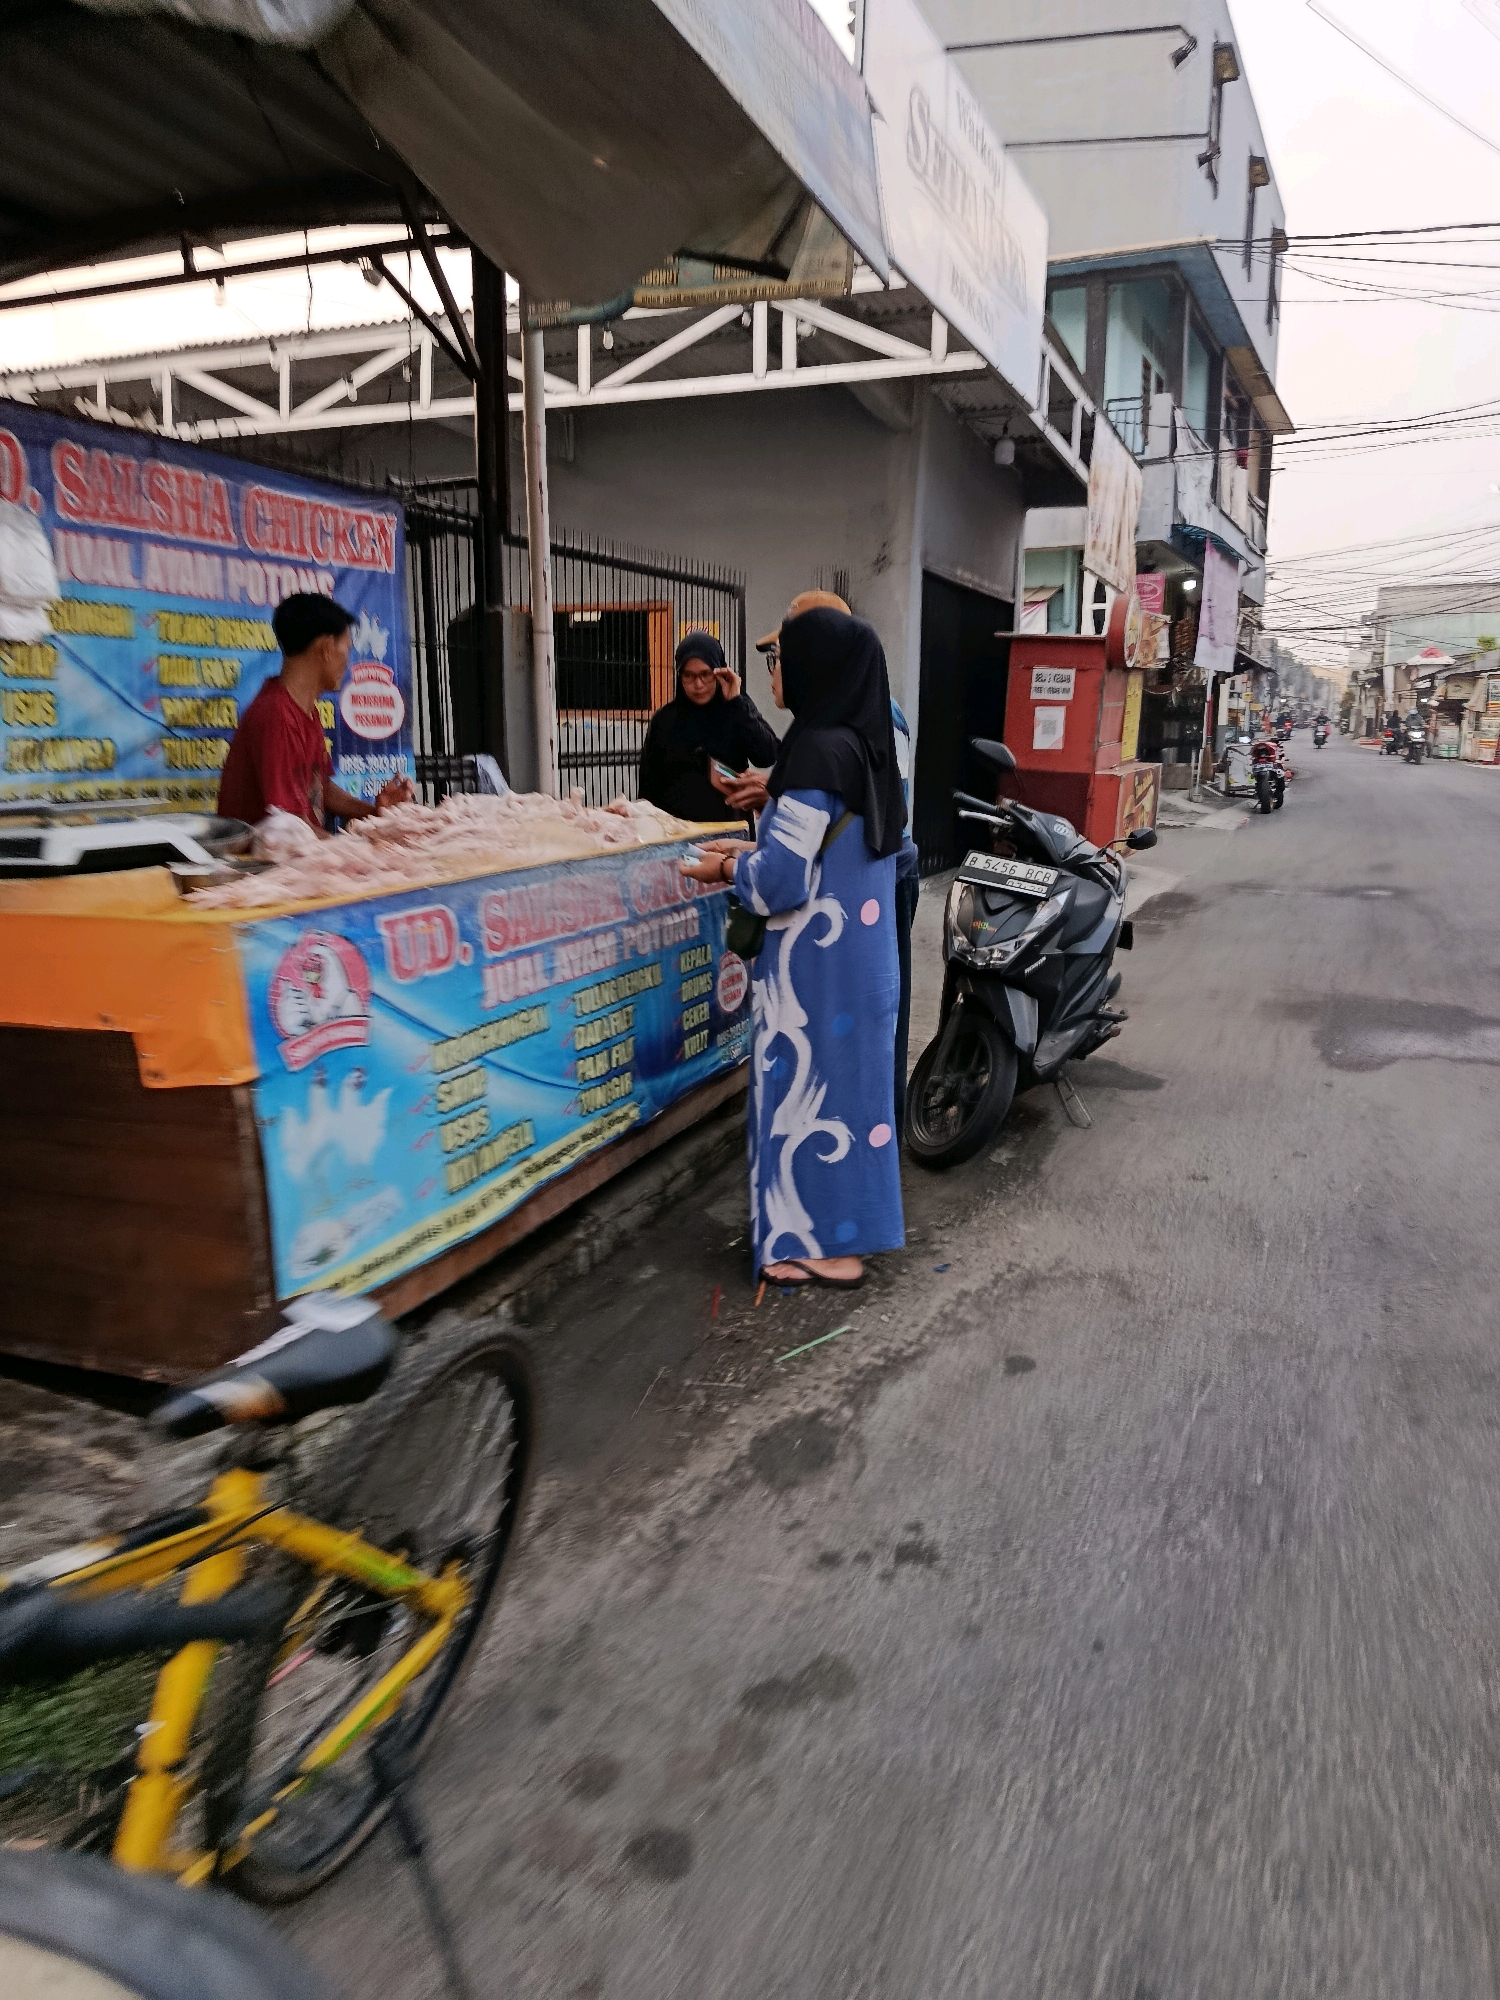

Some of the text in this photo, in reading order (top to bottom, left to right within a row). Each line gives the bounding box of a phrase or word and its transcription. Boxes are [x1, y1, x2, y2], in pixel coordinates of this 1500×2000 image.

[241, 482, 398, 574] CHICKEN
[376, 904, 475, 986] UD.
[482, 905, 700, 1012] JUAL AYAM POTONG
[679, 943, 713, 974] KEPALA
[681, 970, 713, 1003] DRUMS
[682, 1001, 711, 1031] CEKER
[684, 1029, 710, 1060] KULIT
